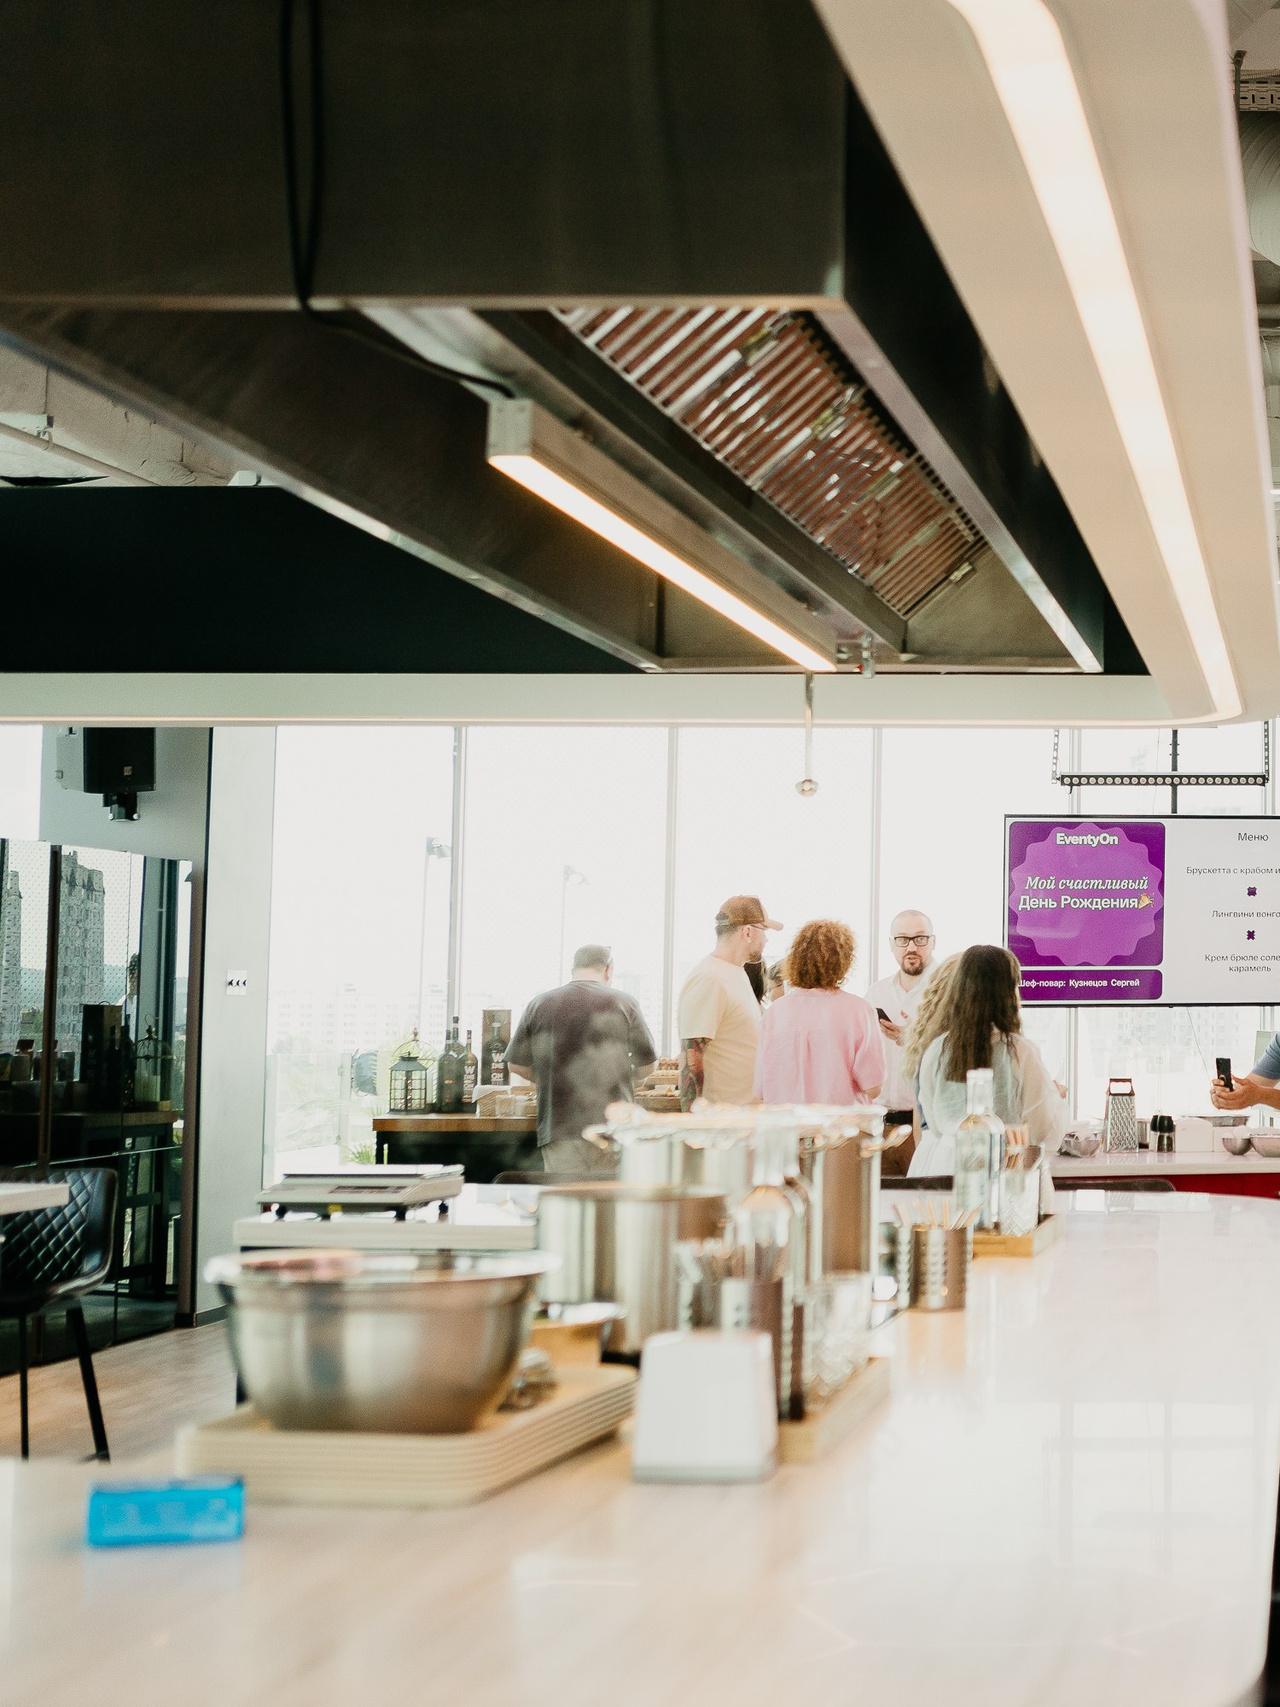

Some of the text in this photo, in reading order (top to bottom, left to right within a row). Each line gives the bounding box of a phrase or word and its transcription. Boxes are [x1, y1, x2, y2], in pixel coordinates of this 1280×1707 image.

[1056, 832, 1119, 847] EventyOn
[1237, 832, 1269, 841] Меню
[1186, 866, 1231, 875] Брускетта
[1240, 866, 1273, 875] крабом
[1024, 876, 1149, 890] Мой счастливый
[1018, 895, 1139, 911] День Рождения
[1211, 910, 1255, 918] Лингвини
[1204, 954, 1229, 962] Крем
[1230, 953, 1259, 962] брюле
[1069, 979, 1108, 988] Кузнецов
[1110, 978, 1140, 988] Сергей
